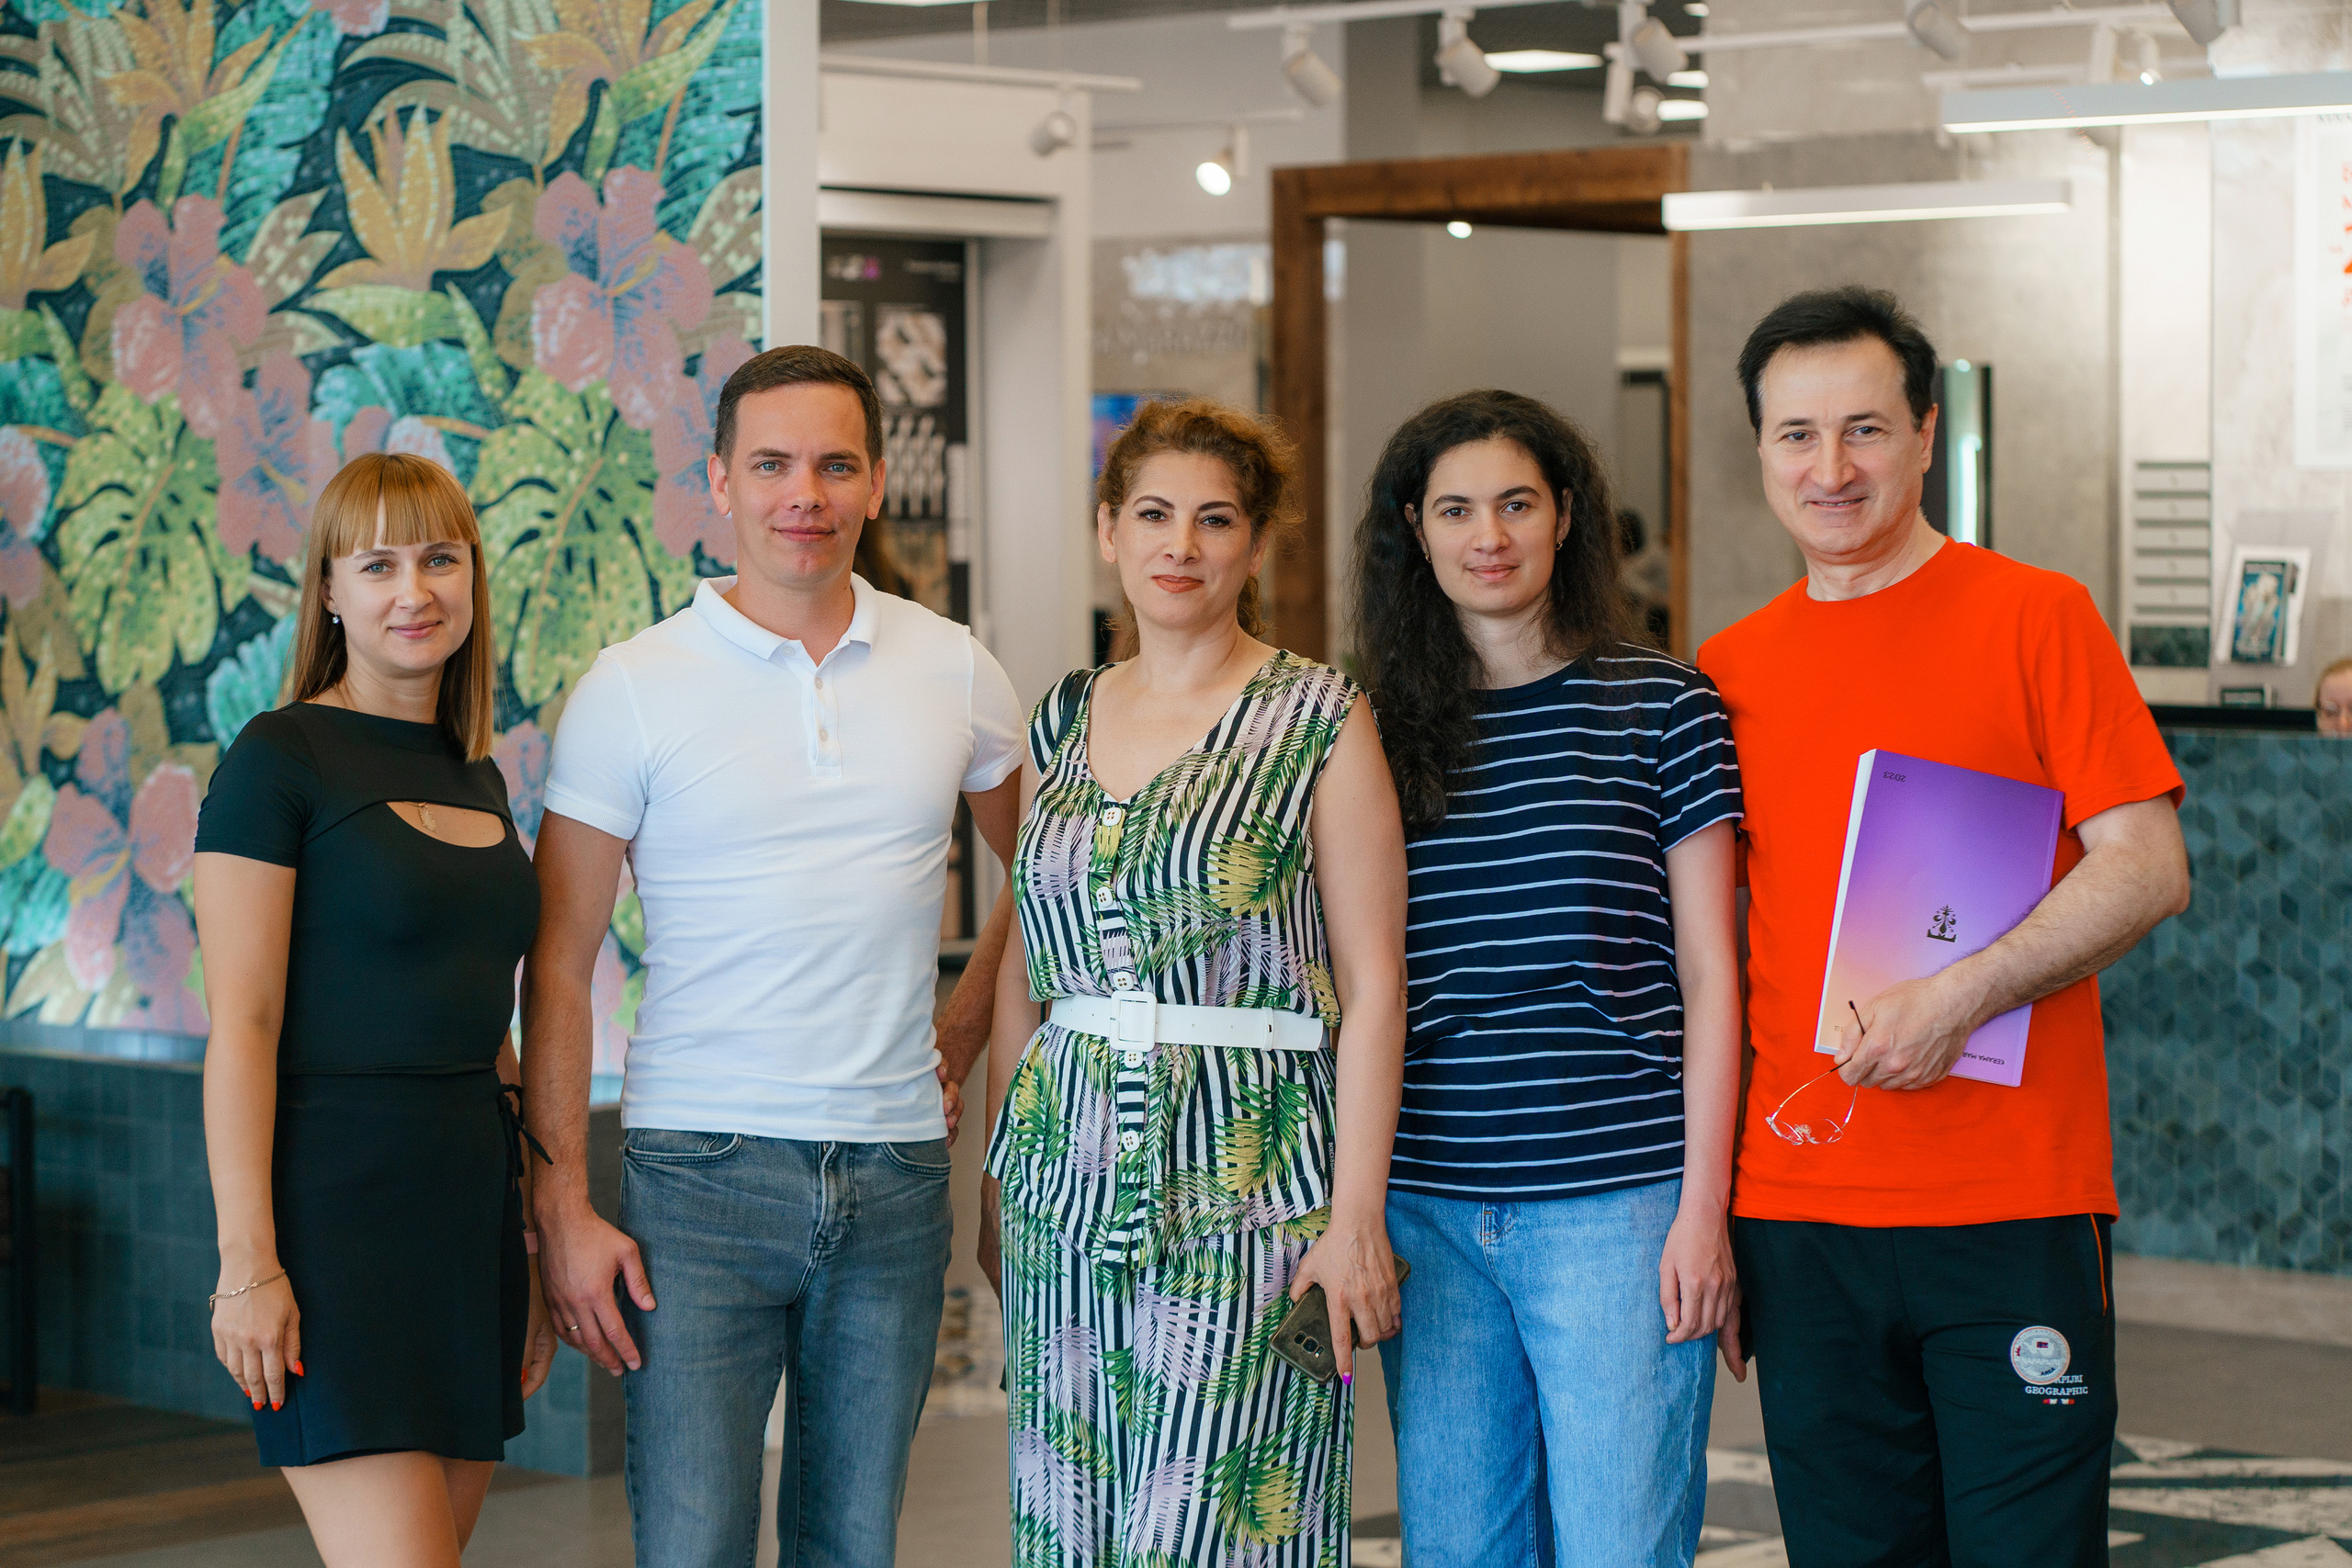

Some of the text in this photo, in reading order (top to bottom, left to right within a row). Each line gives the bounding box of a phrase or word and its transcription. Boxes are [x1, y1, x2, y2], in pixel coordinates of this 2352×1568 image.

[1883, 771, 1906, 783] 2023
[1962, 1052, 2005, 1066] KERAMA MAR
[2054, 1374, 2084, 1384] APIJRI
[2025, 1385, 2088, 1396] GEOGRAPHIC
